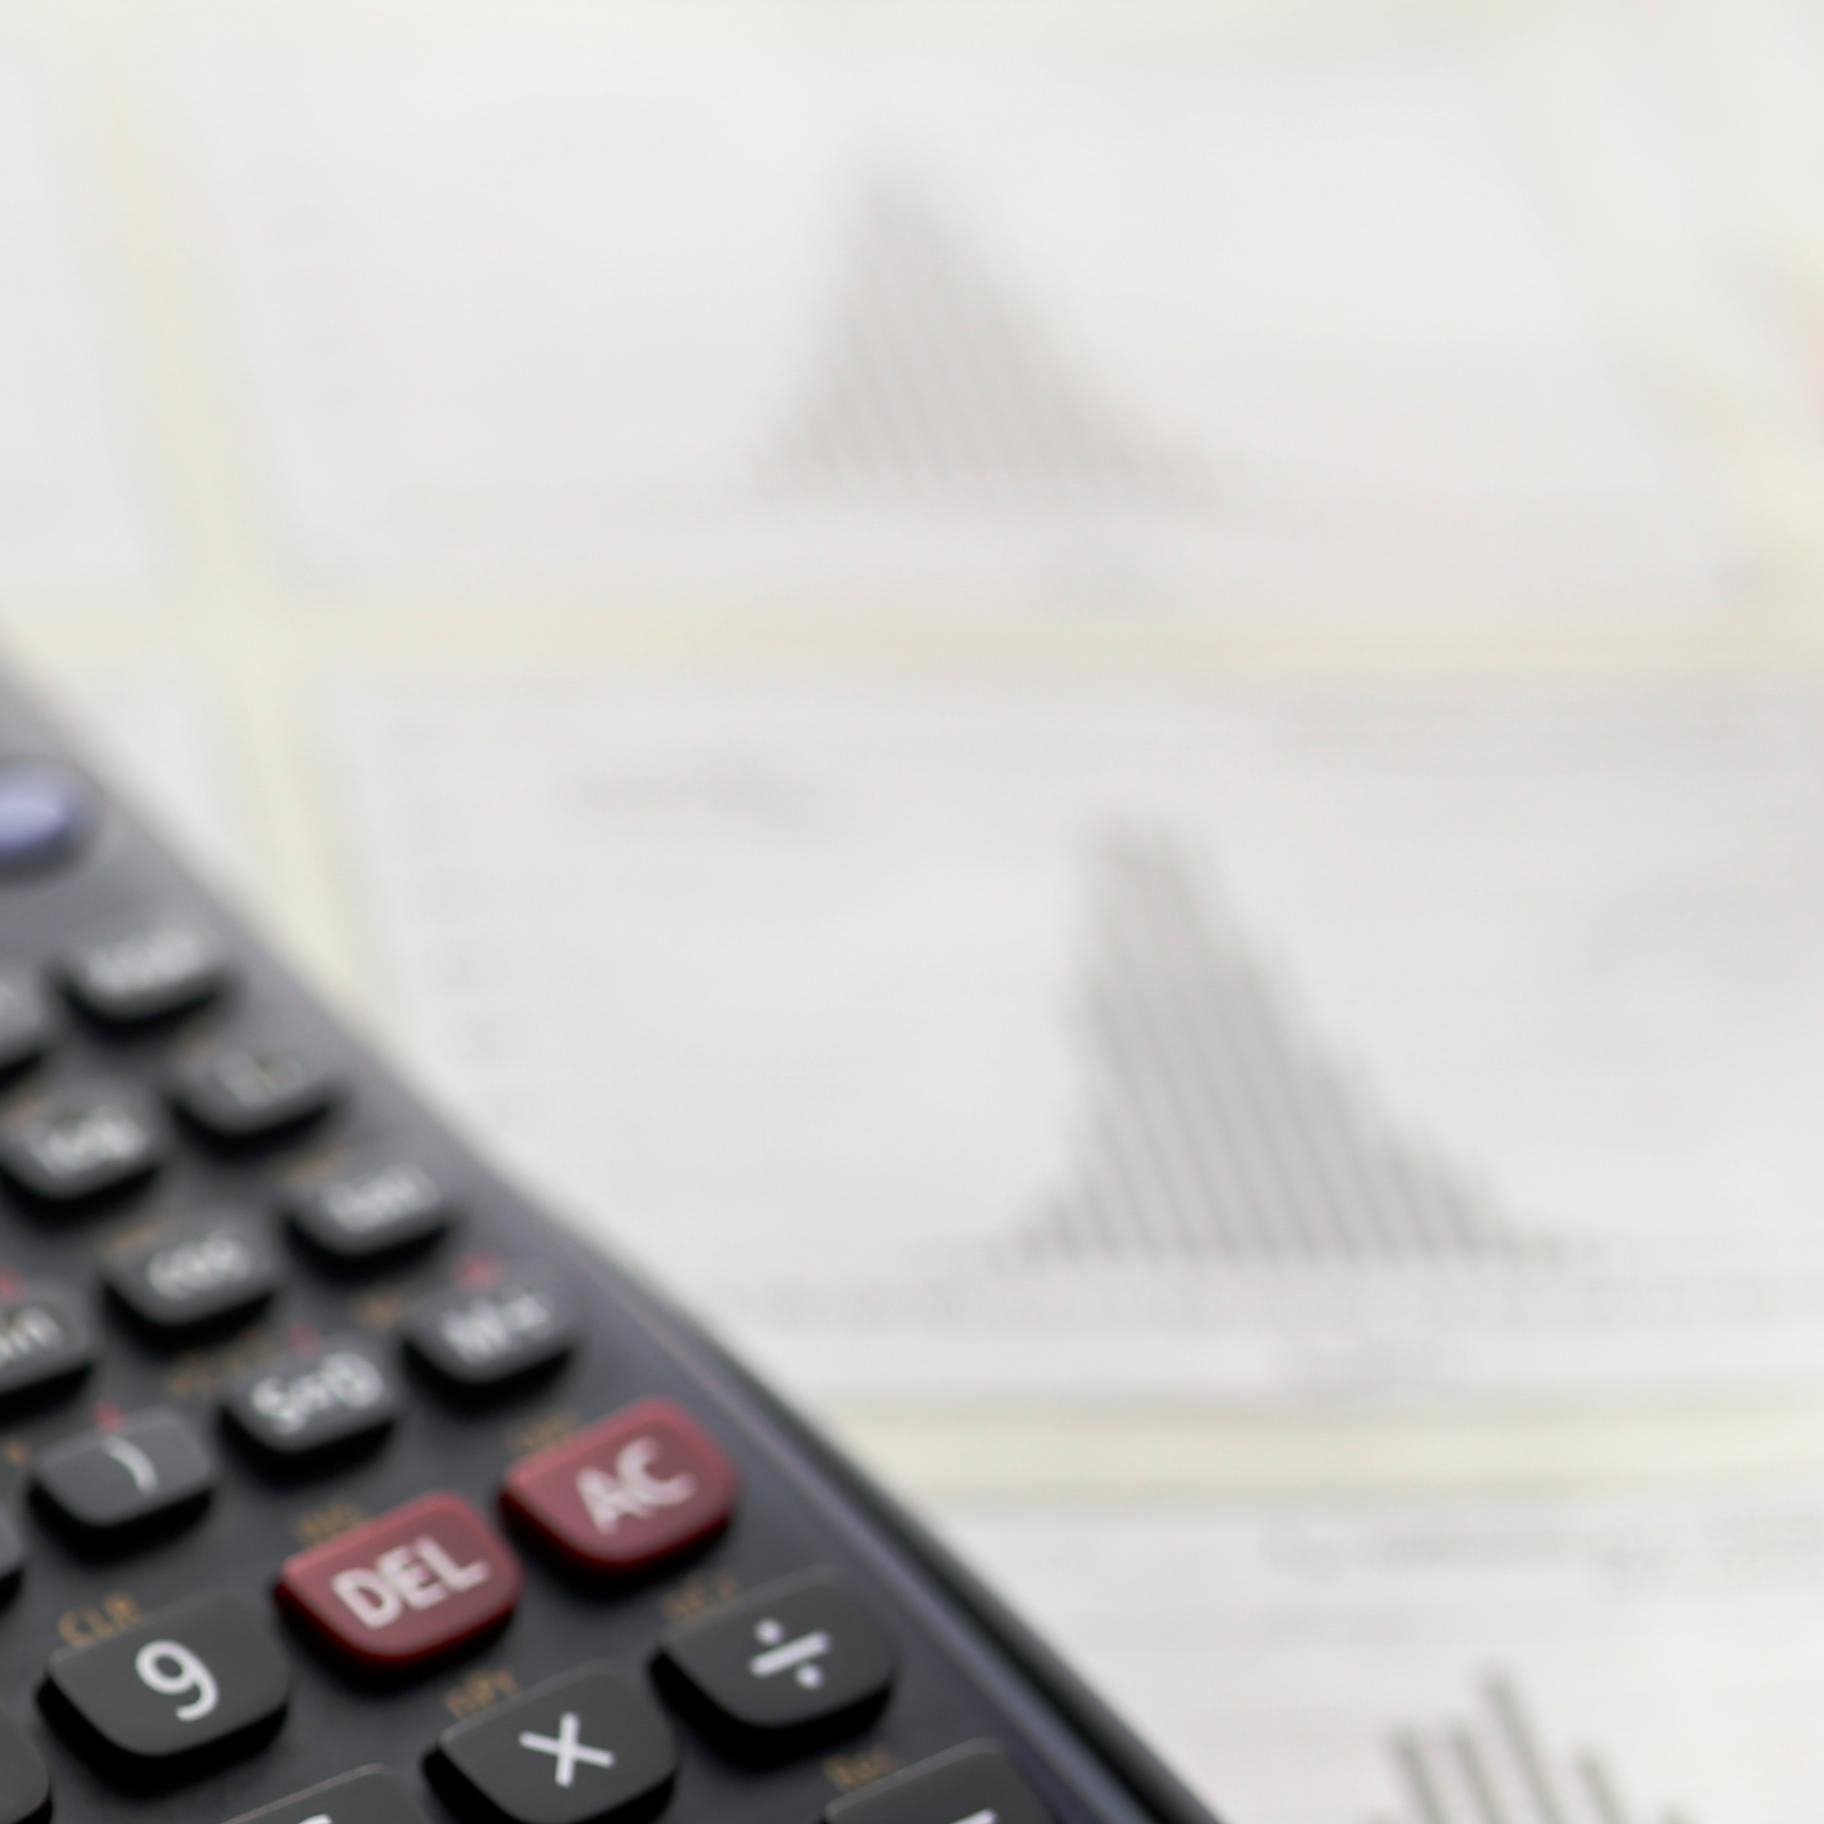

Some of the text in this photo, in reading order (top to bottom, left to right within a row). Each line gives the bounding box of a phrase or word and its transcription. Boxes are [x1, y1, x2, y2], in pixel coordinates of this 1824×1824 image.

[575, 1434, 699, 1535] AC
[331, 1535, 491, 1630] DEL
[134, 1639, 221, 1722] 9
